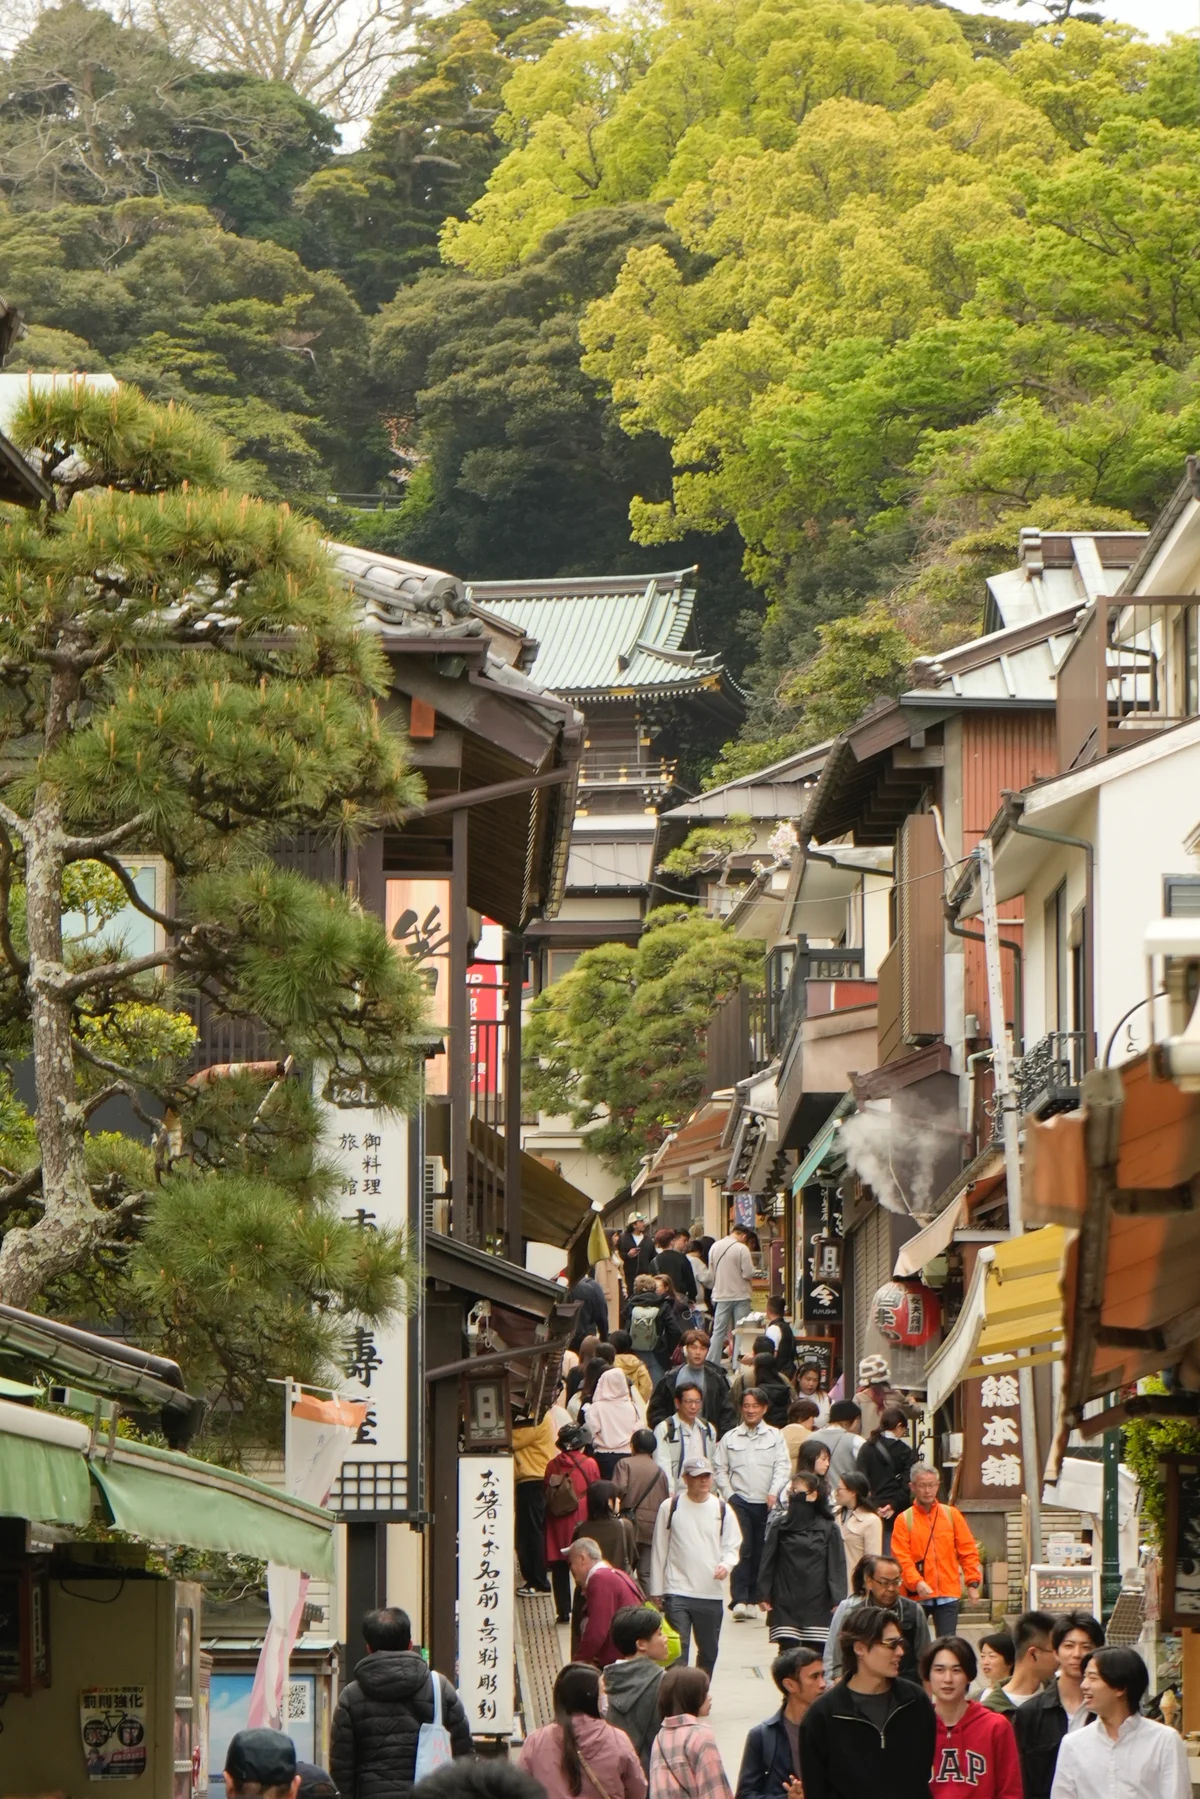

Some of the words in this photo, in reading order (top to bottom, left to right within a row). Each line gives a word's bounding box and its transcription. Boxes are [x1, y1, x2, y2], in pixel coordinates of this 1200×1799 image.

[339, 1133, 359, 1196] 旅館
[361, 1133, 382, 1196] 御料理
[1053, 1546, 1084, 1556] こちら
[928, 1748, 987, 1787] AP
